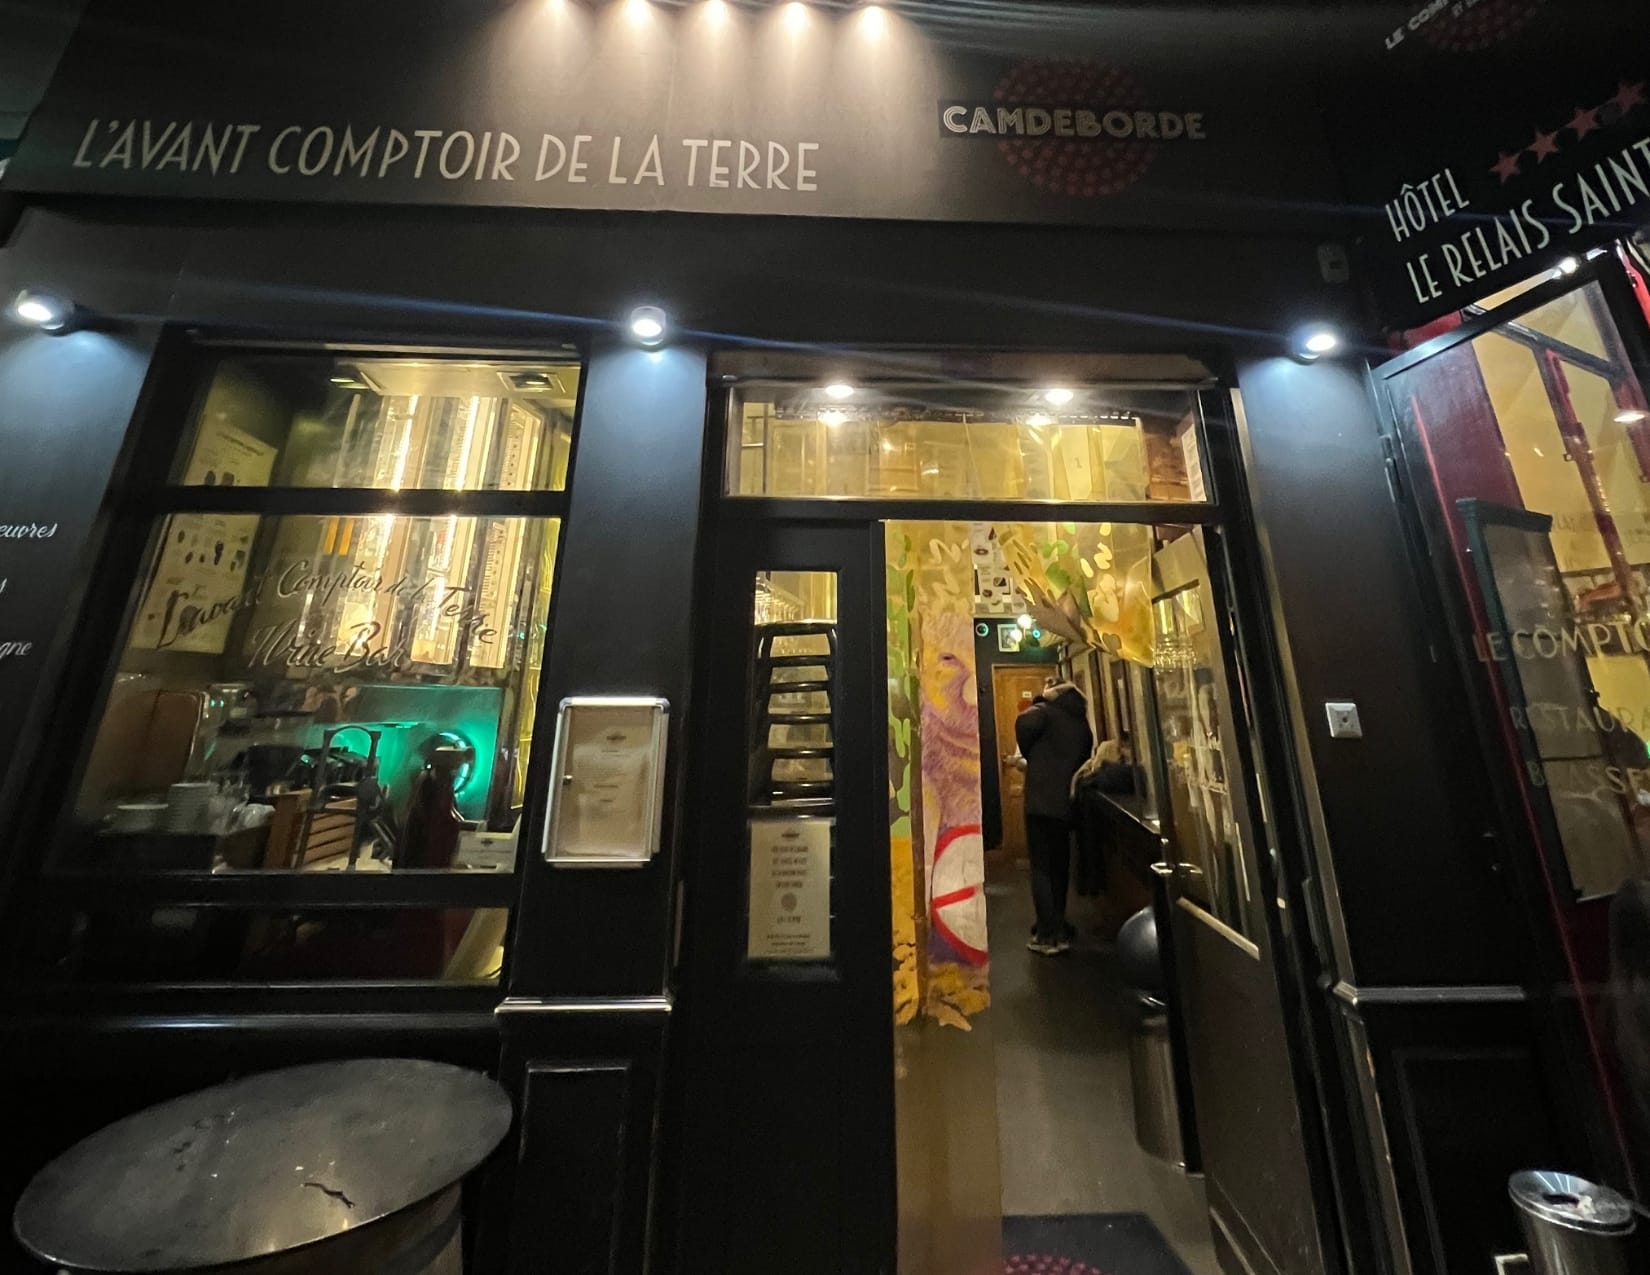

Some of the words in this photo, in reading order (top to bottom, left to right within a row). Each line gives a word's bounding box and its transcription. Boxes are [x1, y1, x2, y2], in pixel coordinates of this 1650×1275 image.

[943, 105, 1206, 140] CAMDEBORDE
[72, 119, 260, 173] L'AVANT
[268, 126, 522, 182] COMPTOIR
[534, 134, 592, 184] DE
[607, 135, 665, 187] LA
[682, 138, 819, 192] TERRE
[1385, 168, 1470, 243] HÔTEL
[1406, 253, 1443, 304] LE
[1441, 198, 1550, 288] RELAIS
[1552, 136, 1650, 235] SAINT
[277, 559, 384, 606] Comptoir
[334, 621, 406, 673] Bar
[1509, 704, 1650, 733] RSTAUR
